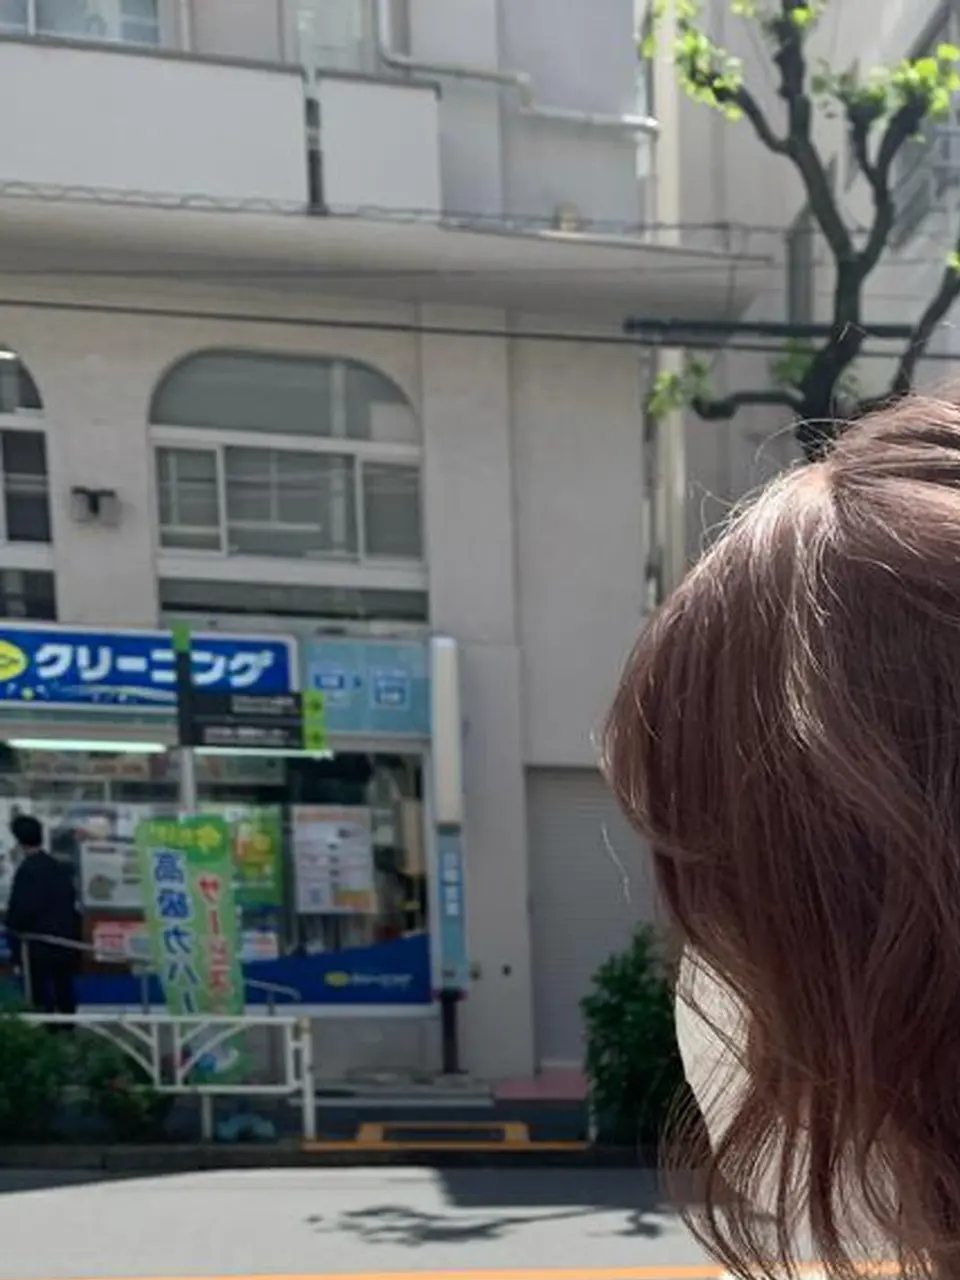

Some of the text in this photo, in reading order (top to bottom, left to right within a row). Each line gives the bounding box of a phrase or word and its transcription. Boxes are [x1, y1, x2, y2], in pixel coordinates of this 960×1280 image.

[34, 642, 275, 688] クリーニング
